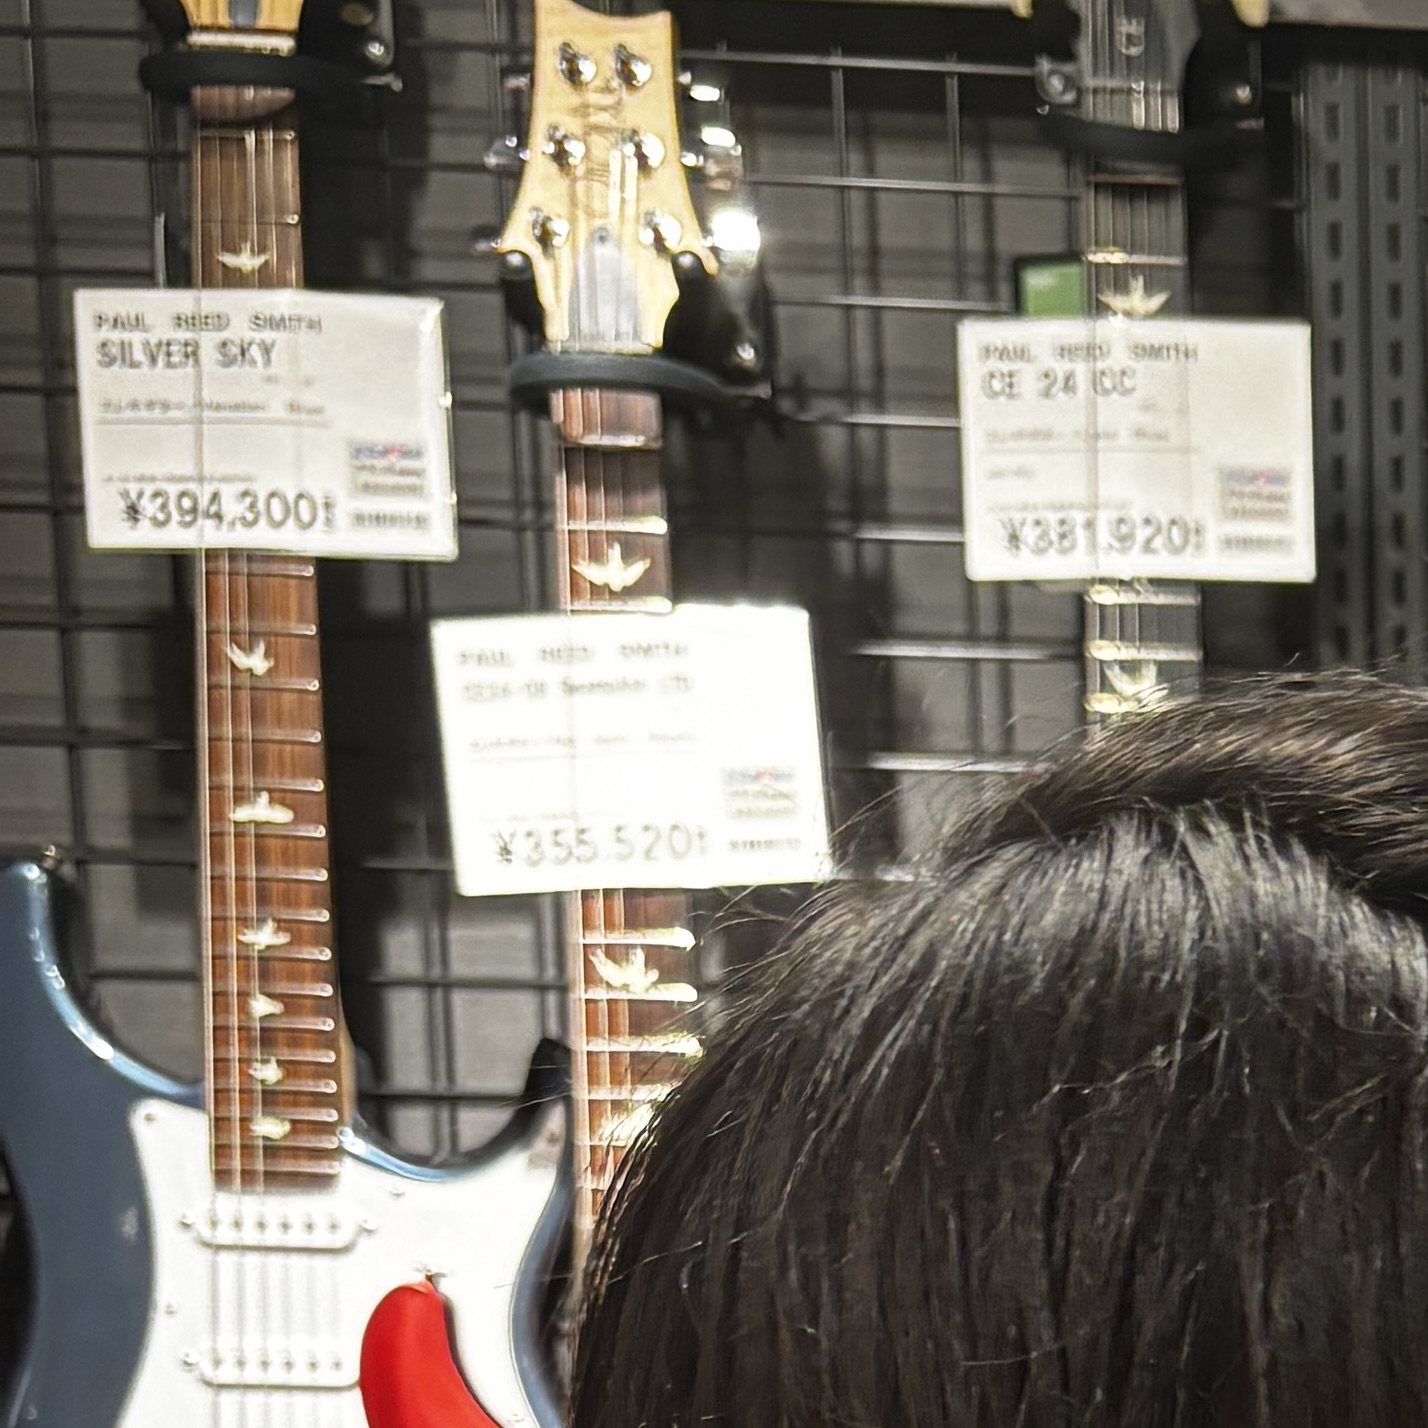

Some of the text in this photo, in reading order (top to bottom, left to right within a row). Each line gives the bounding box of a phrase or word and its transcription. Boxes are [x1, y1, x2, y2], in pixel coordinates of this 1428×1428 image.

[93, 311, 151, 333] PAUL
[96, 338, 277, 370] SILVER SKY
[1037, 368, 1078, 399] 24
